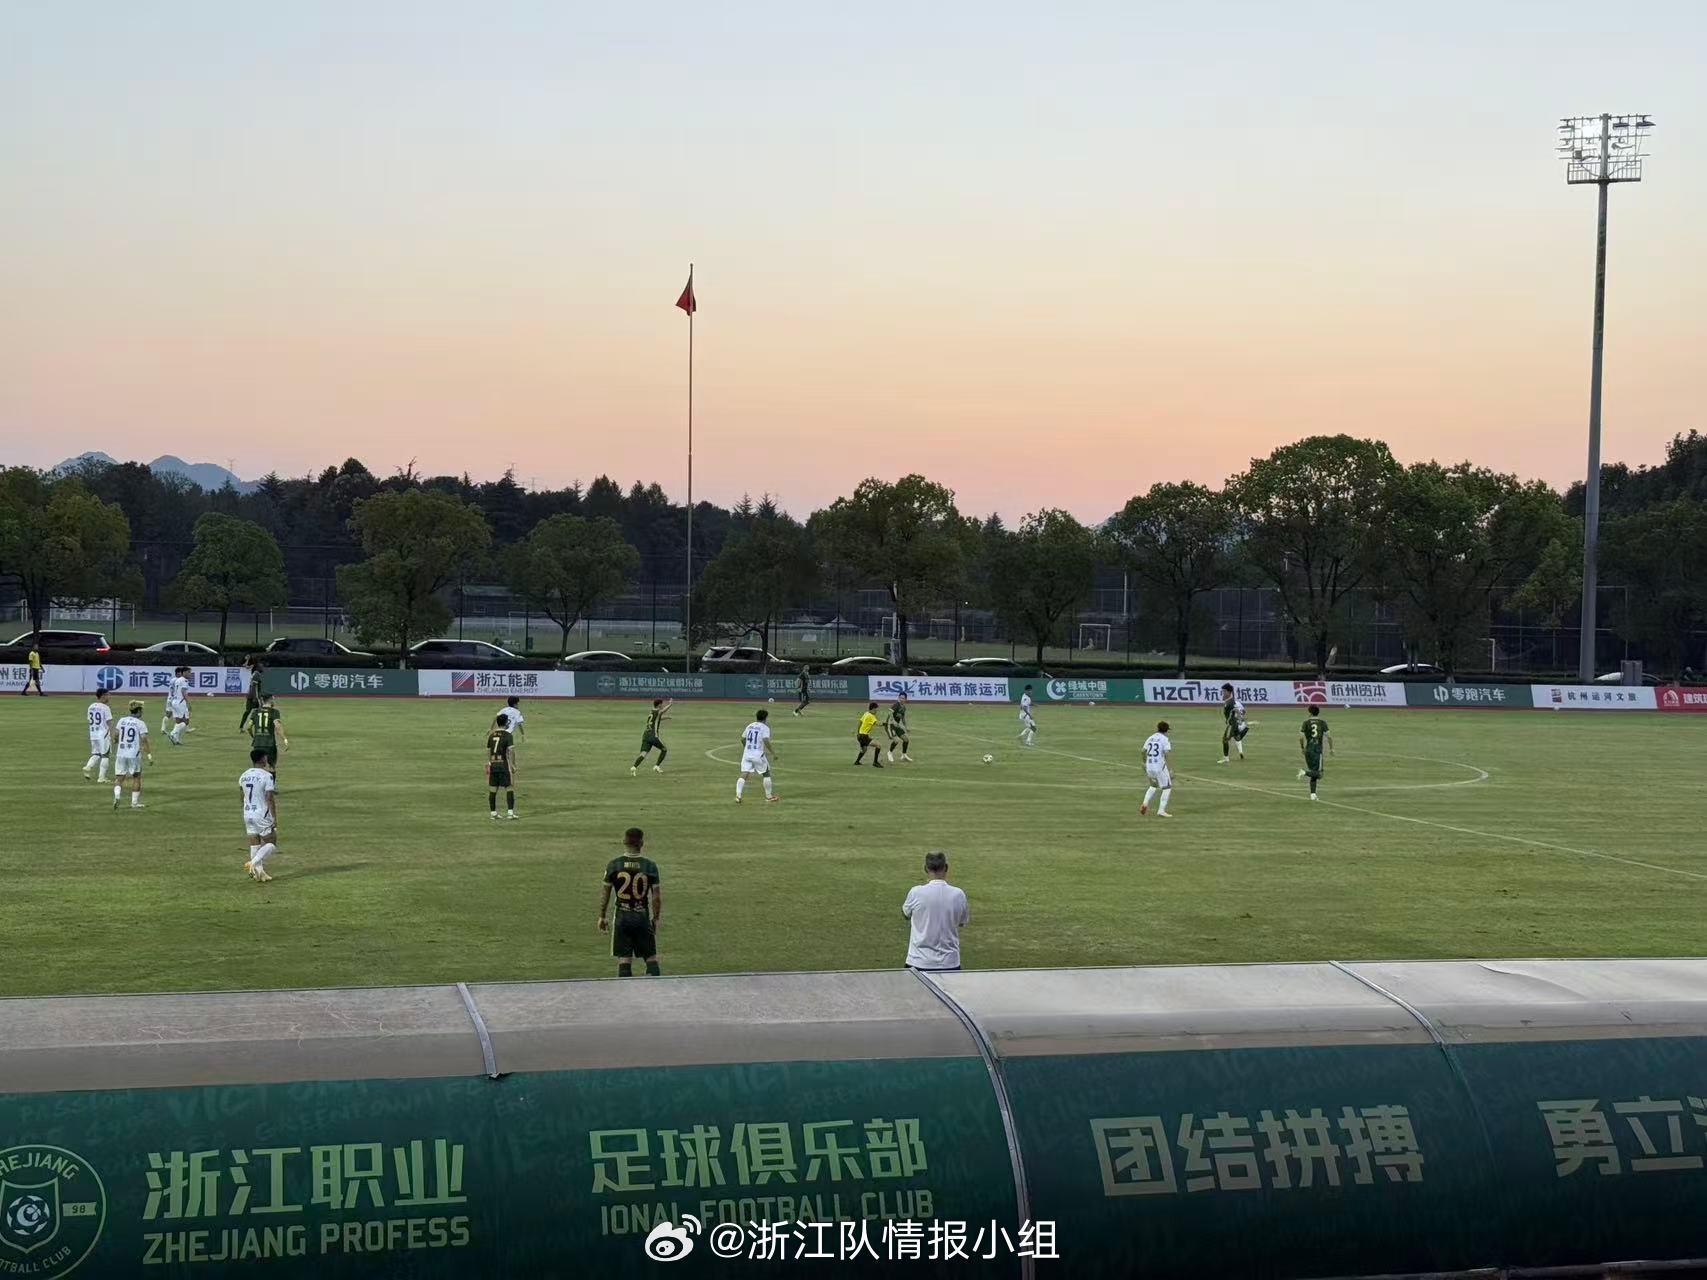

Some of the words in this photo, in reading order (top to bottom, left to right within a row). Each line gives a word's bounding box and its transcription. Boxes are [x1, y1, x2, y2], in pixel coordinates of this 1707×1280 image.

[314, 673, 384, 689] 零跑汽车
[476, 672, 538, 687] 浙江能源
[1067, 680, 1107, 691] 绿城中国
[918, 682, 1007, 697] 杭州商旅运河
[1204, 687, 1269, 702] 杭城投
[1451, 687, 1506, 702] 零跑汽车
[90, 711, 102, 726] 39
[257, 712, 269, 728] 11
[120, 726, 136, 743] 19
[747, 730, 759, 744] 41
[1311, 723, 1318, 738] 3
[493, 736, 501, 754] 7
[1147, 742, 1160, 757] 23
[245, 783, 254, 804] 7
[616, 871, 648, 900] 20
[1536, 1095, 1707, 1178] 勇立
[589, 1117, 928, 1194] 足球俱乐部
[1089, 1104, 1424, 1196] 团结拼搏
[142, 1139, 468, 1220] 浙江职业
[71, 1204, 86, 1214] 98
[861, 1189, 934, 1221] CLUB
[142, 1224, 306, 1265] ZHEJIANG
[319, 1216, 470, 1255] PROFESS
[43, 1245, 72, 1269] CLUB
